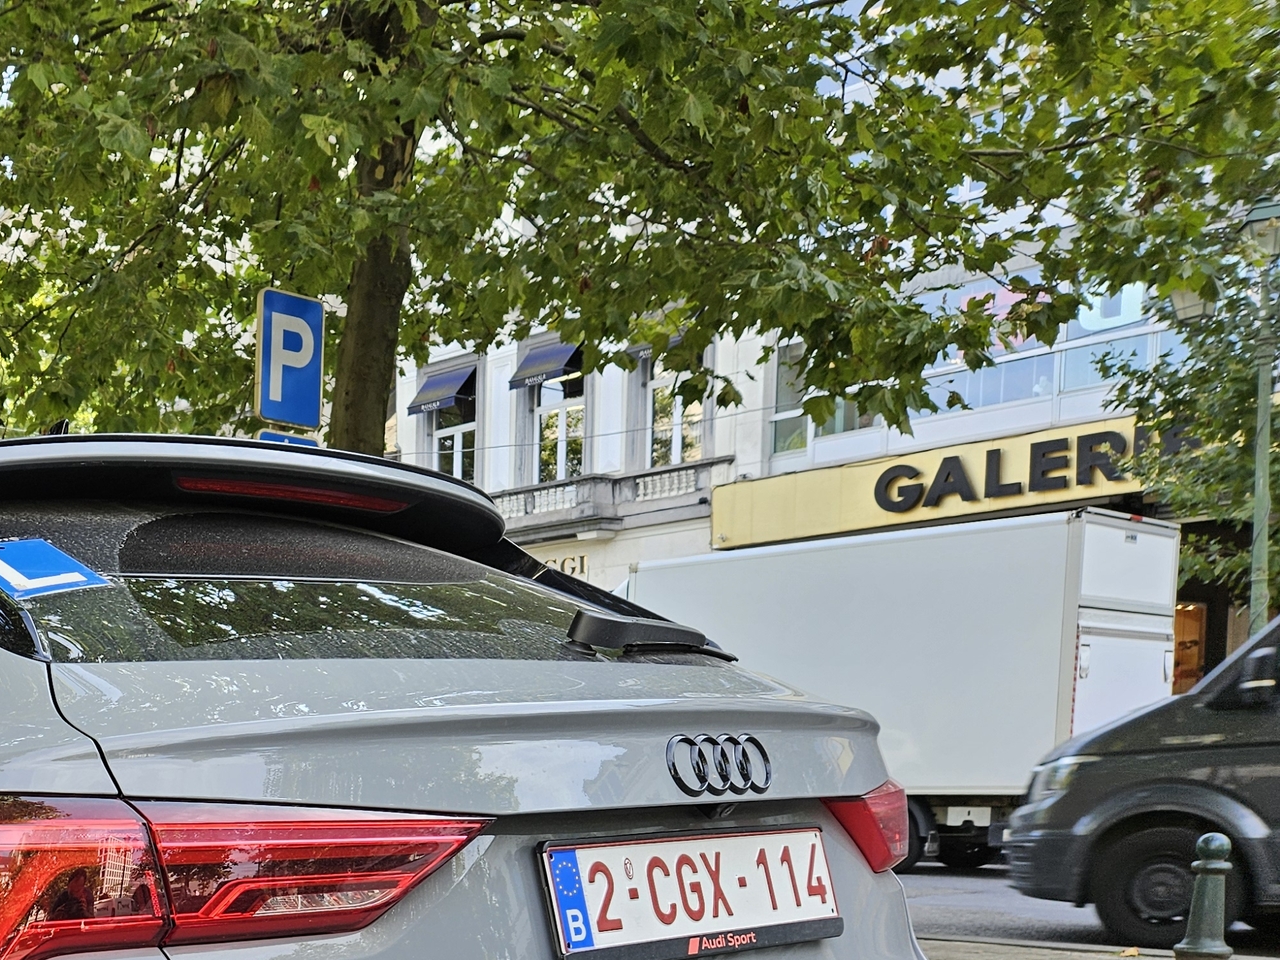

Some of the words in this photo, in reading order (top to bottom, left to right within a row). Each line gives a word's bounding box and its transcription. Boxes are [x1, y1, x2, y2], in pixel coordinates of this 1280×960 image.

[269, 311, 314, 402] P
[566, 908, 587, 942] B
[701, 934, 726, 950] Audi
[727, 931, 757, 949] Sport
